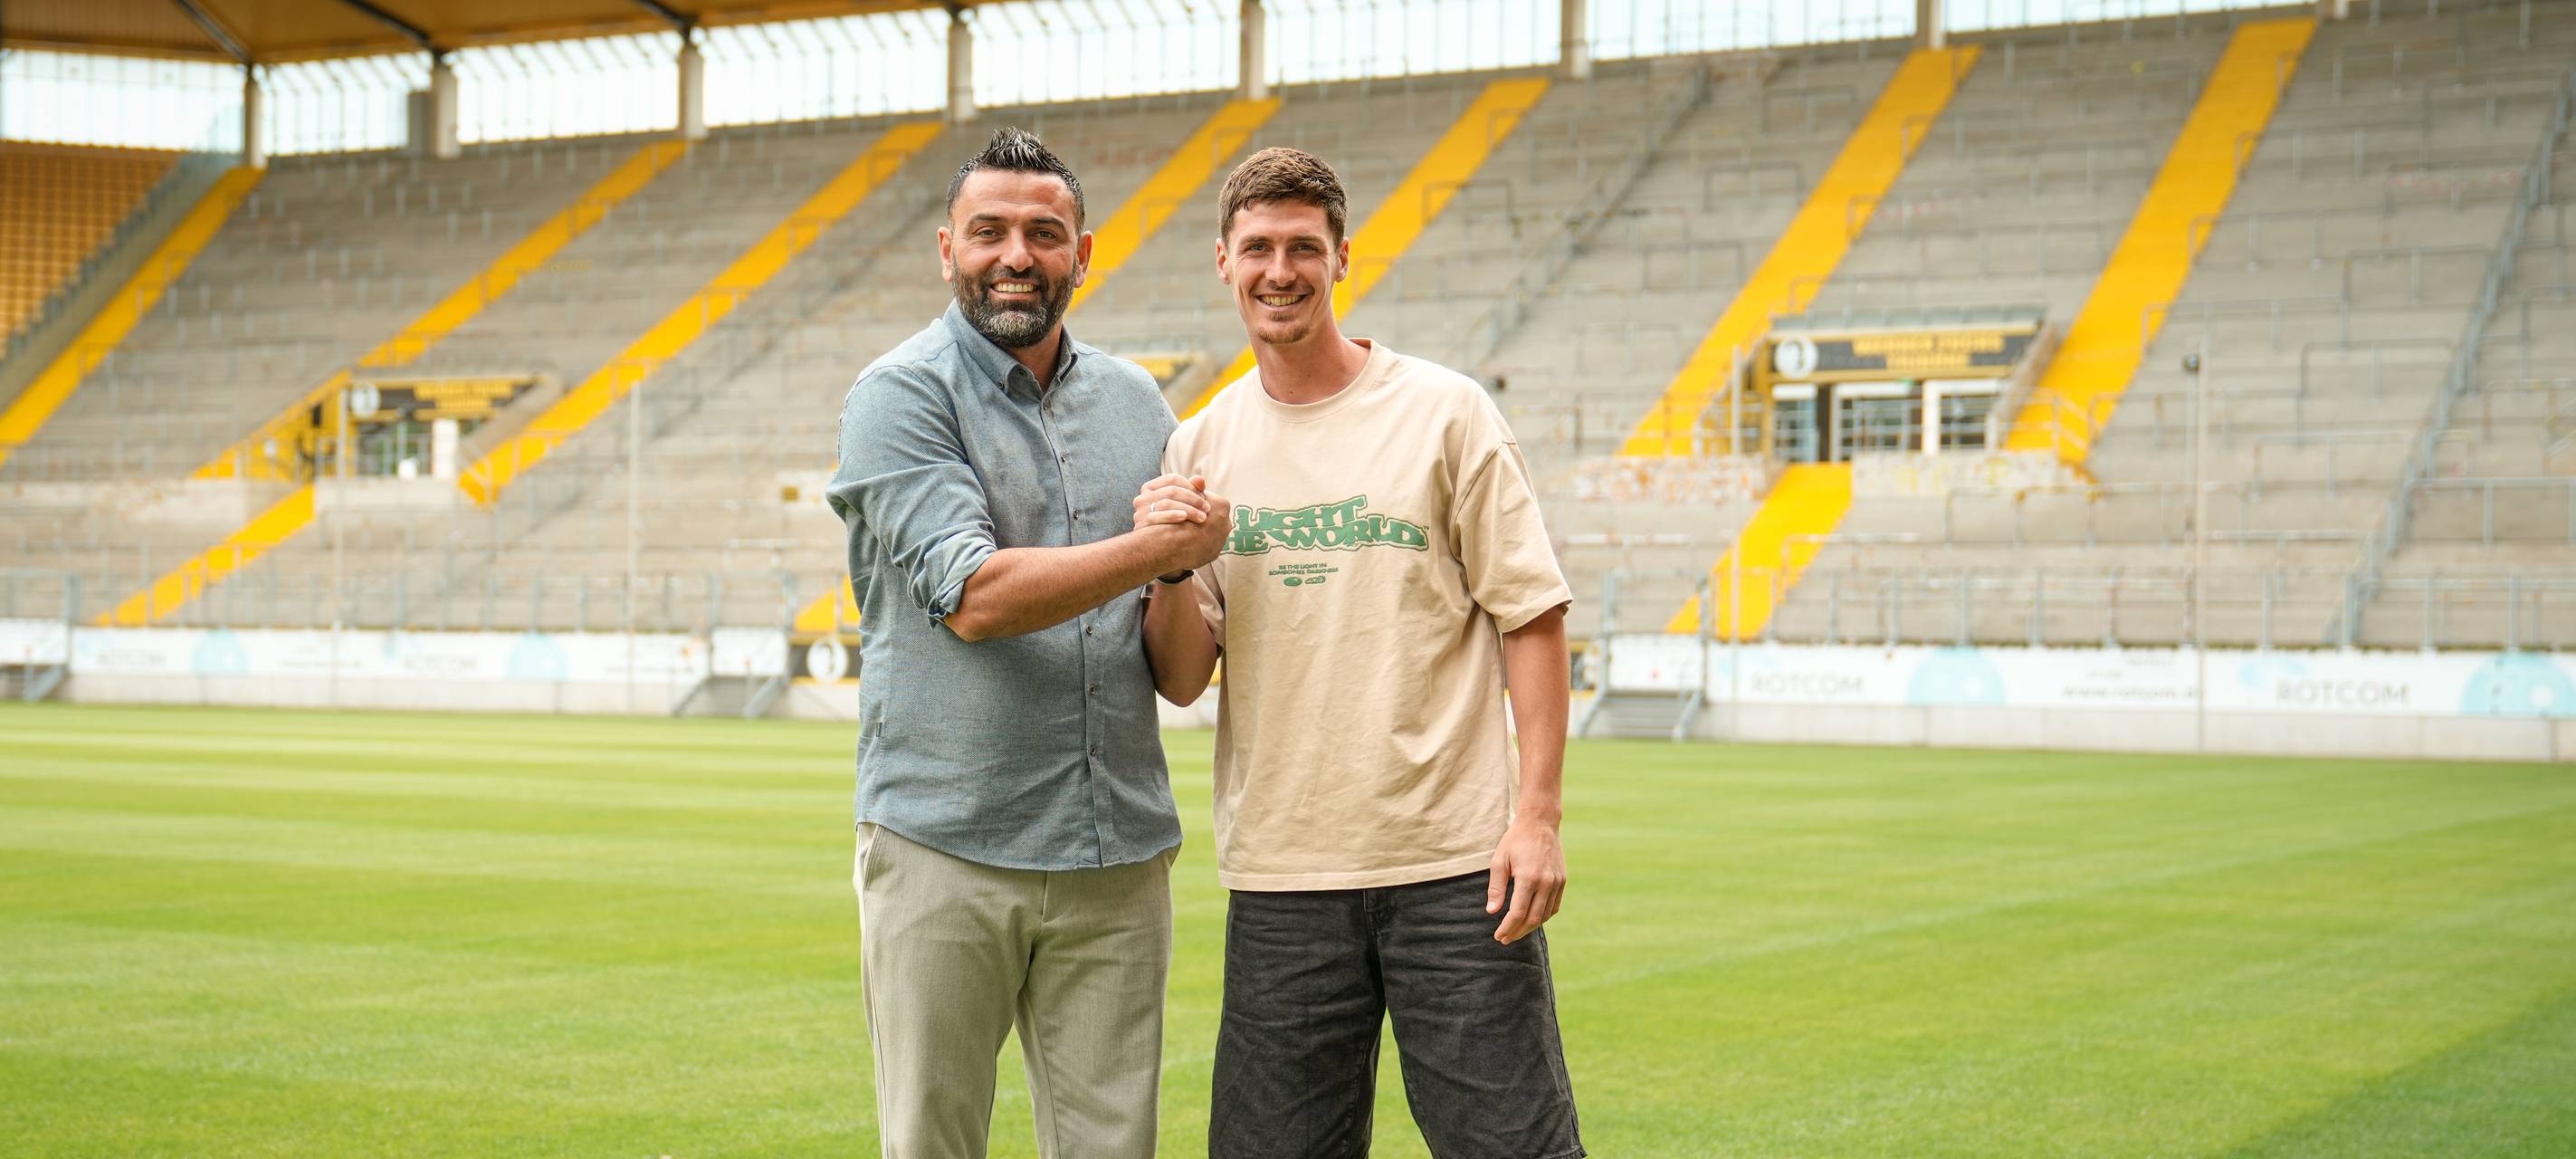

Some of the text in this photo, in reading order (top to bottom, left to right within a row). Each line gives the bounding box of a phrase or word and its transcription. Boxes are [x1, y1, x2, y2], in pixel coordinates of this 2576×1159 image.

[1236, 496, 1366, 531] LIGHT
[1222, 518, 1426, 552] HE WORLD
[1753, 673, 1864, 694] ROTCOM
[2275, 679, 2411, 704] ROTCOM
